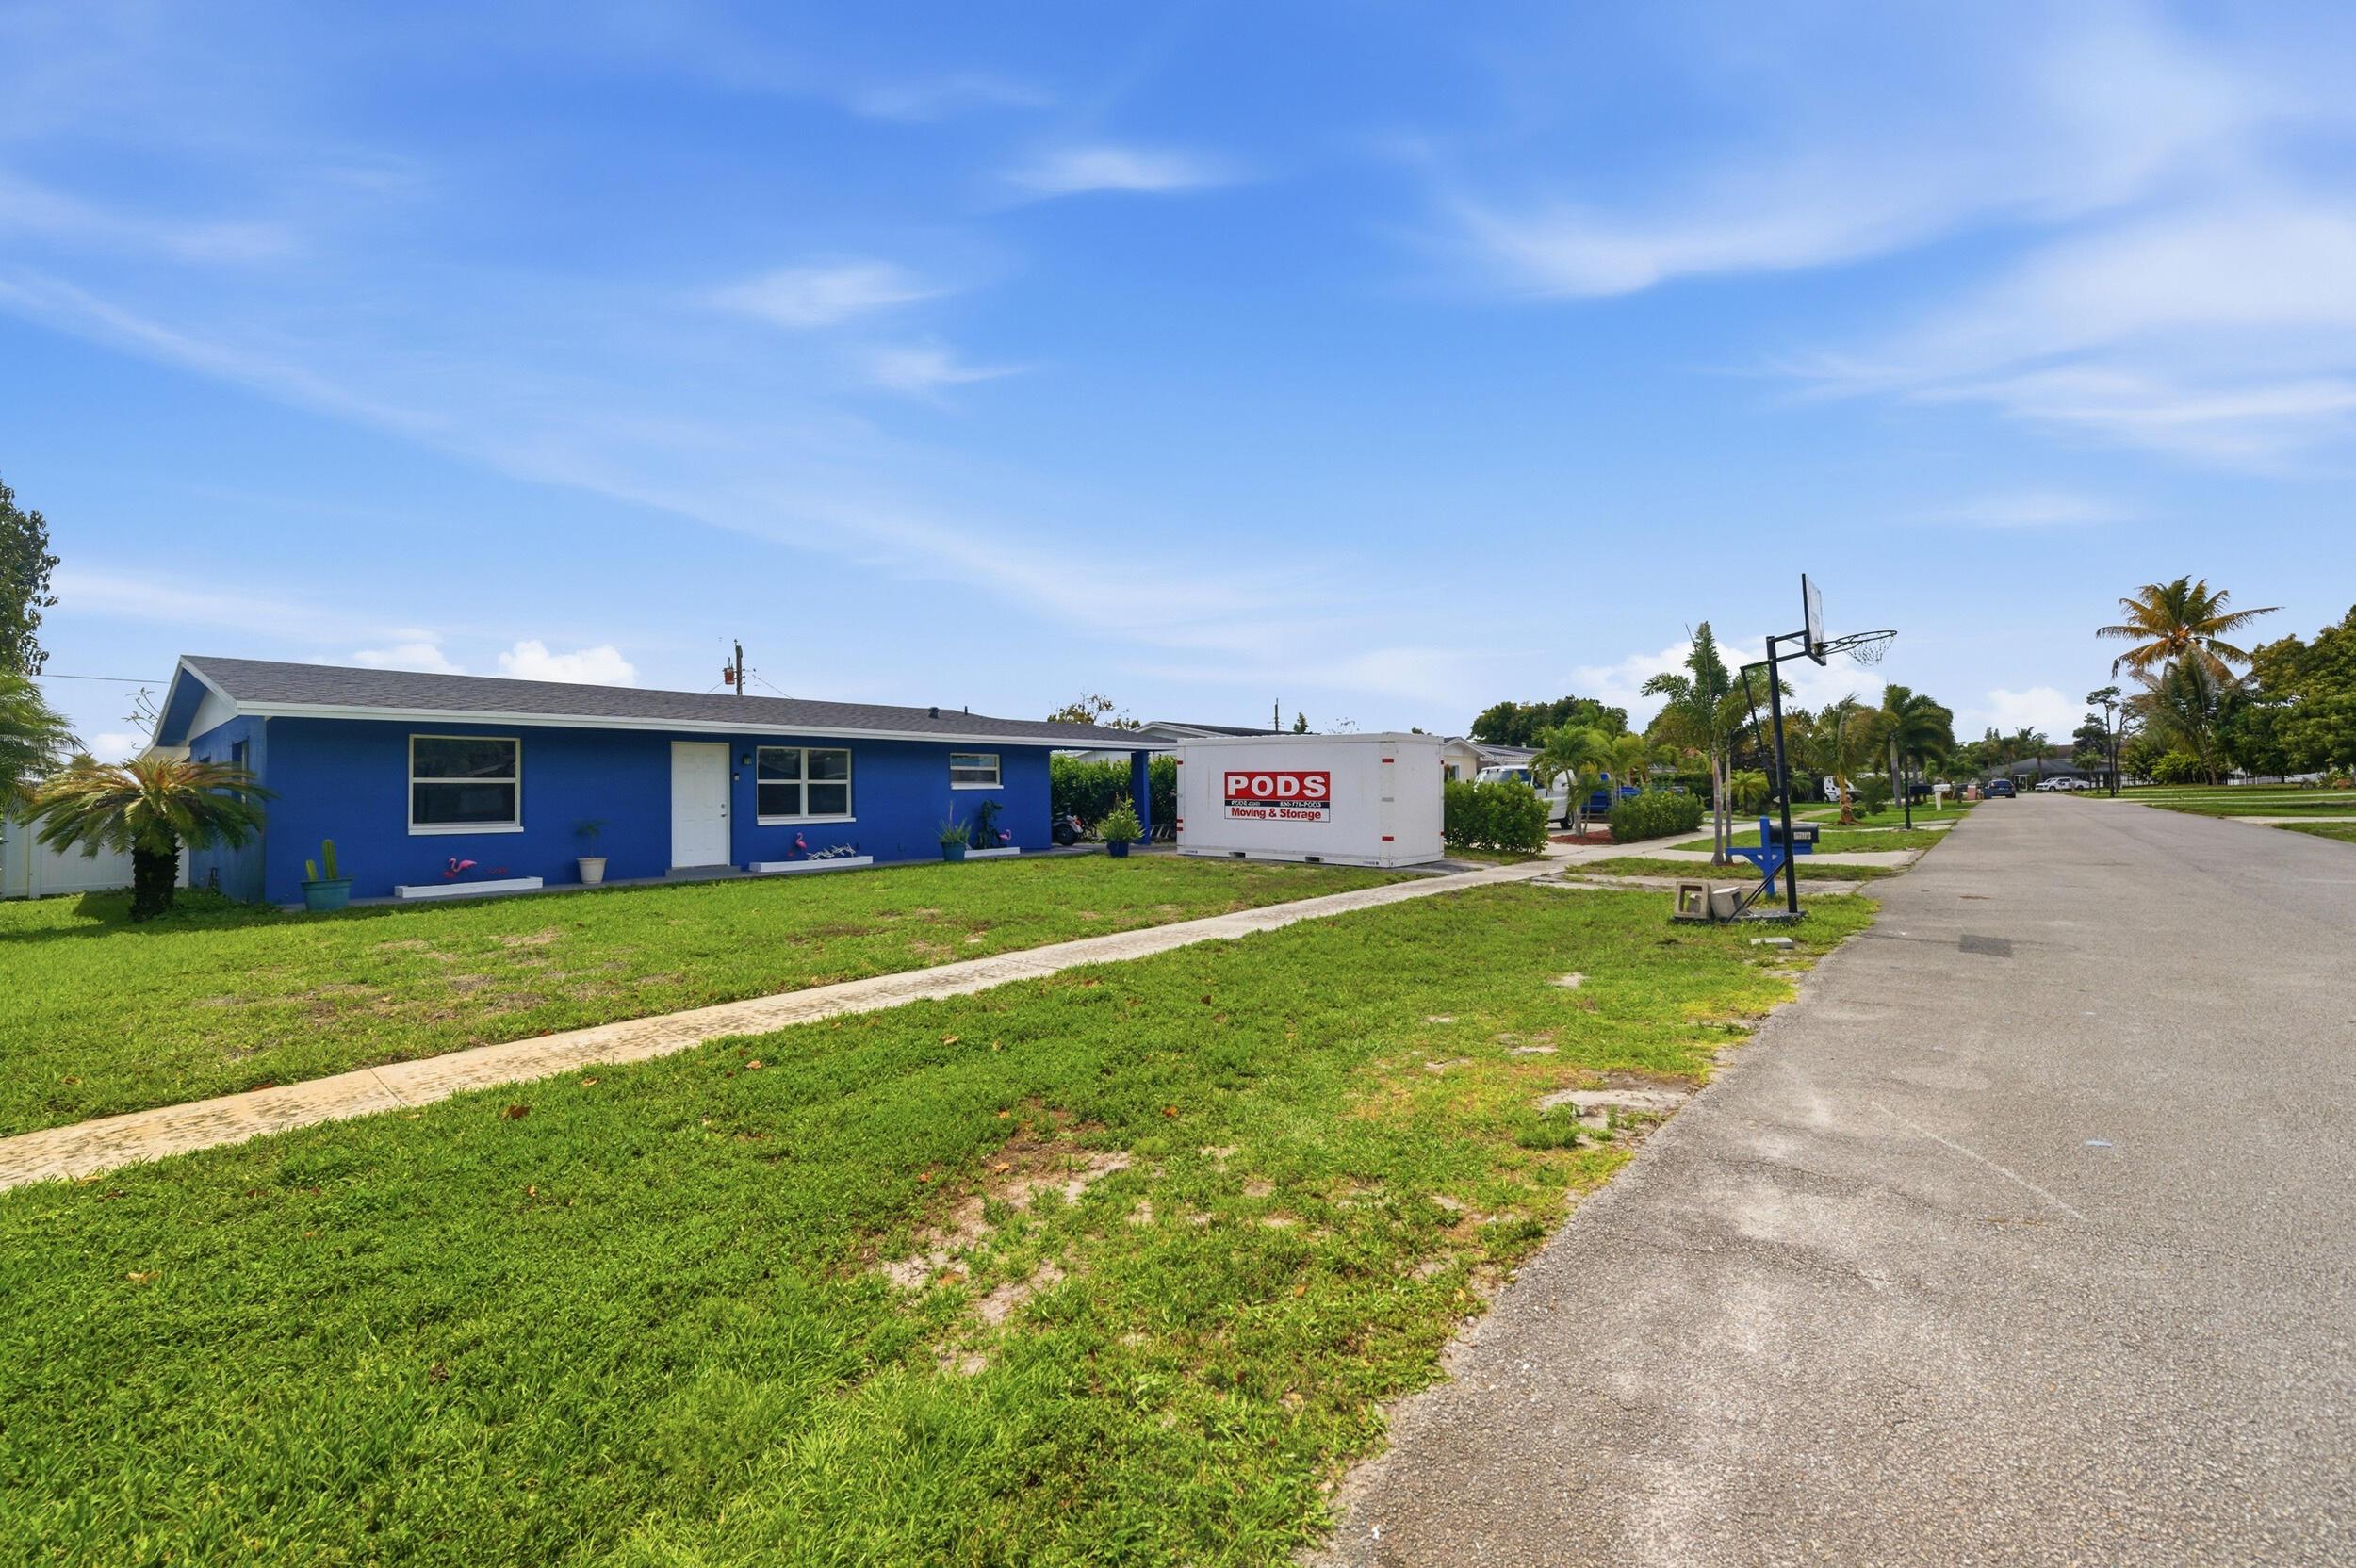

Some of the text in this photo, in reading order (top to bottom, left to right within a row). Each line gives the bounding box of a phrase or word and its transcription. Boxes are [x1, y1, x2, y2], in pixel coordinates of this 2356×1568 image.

[1227, 776, 1327, 797] PODS
[1231, 808, 1322, 821] Moving & Storage
